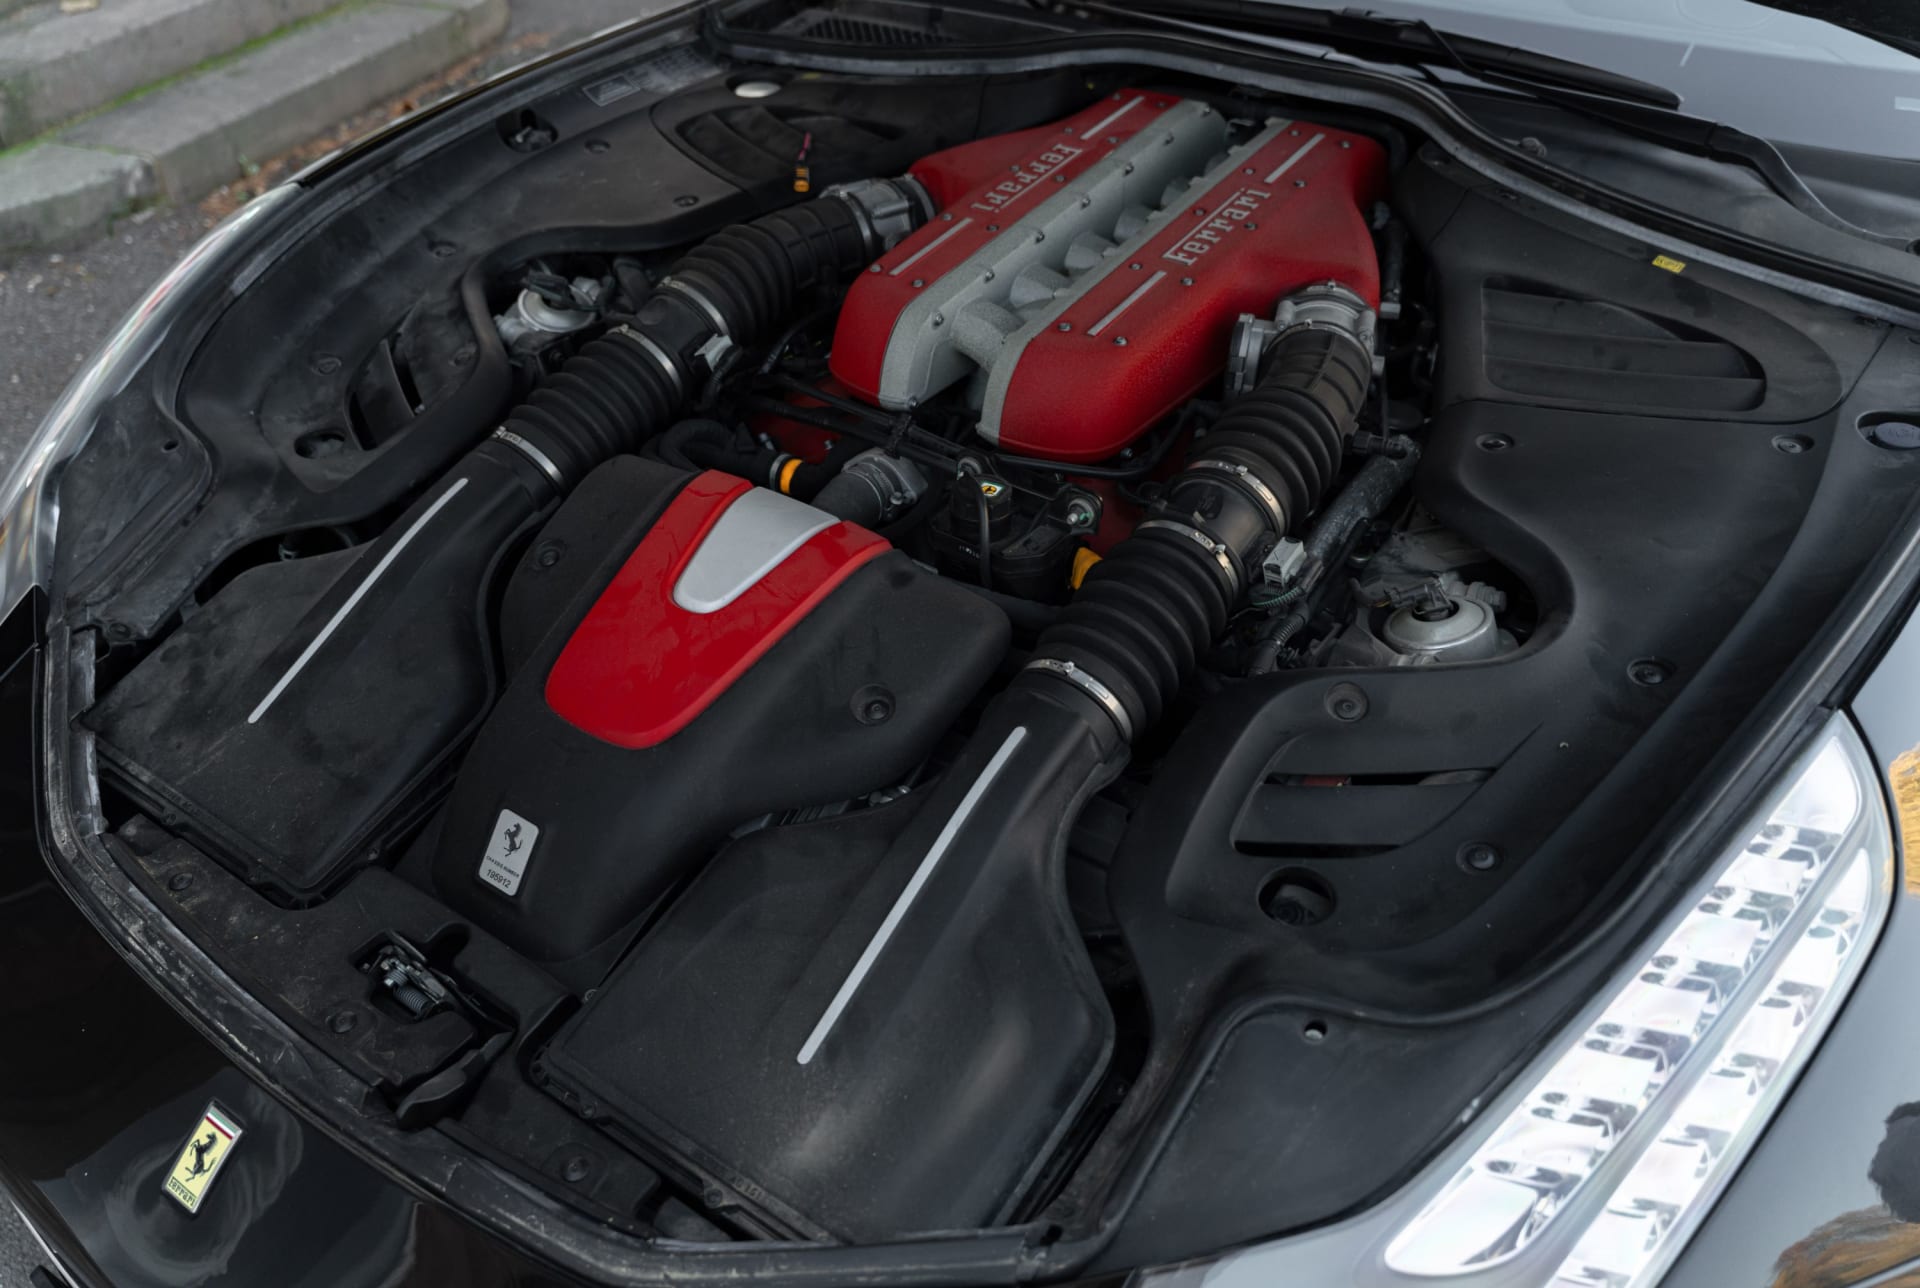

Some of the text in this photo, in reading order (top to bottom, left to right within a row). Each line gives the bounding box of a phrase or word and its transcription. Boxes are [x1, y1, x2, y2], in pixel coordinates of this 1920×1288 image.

[971, 144, 1082, 213] Ferrari
[1162, 188, 1271, 266] Ferrari
[486, 869, 511, 888] 195912
[168, 1176, 197, 1206] Ferrari
